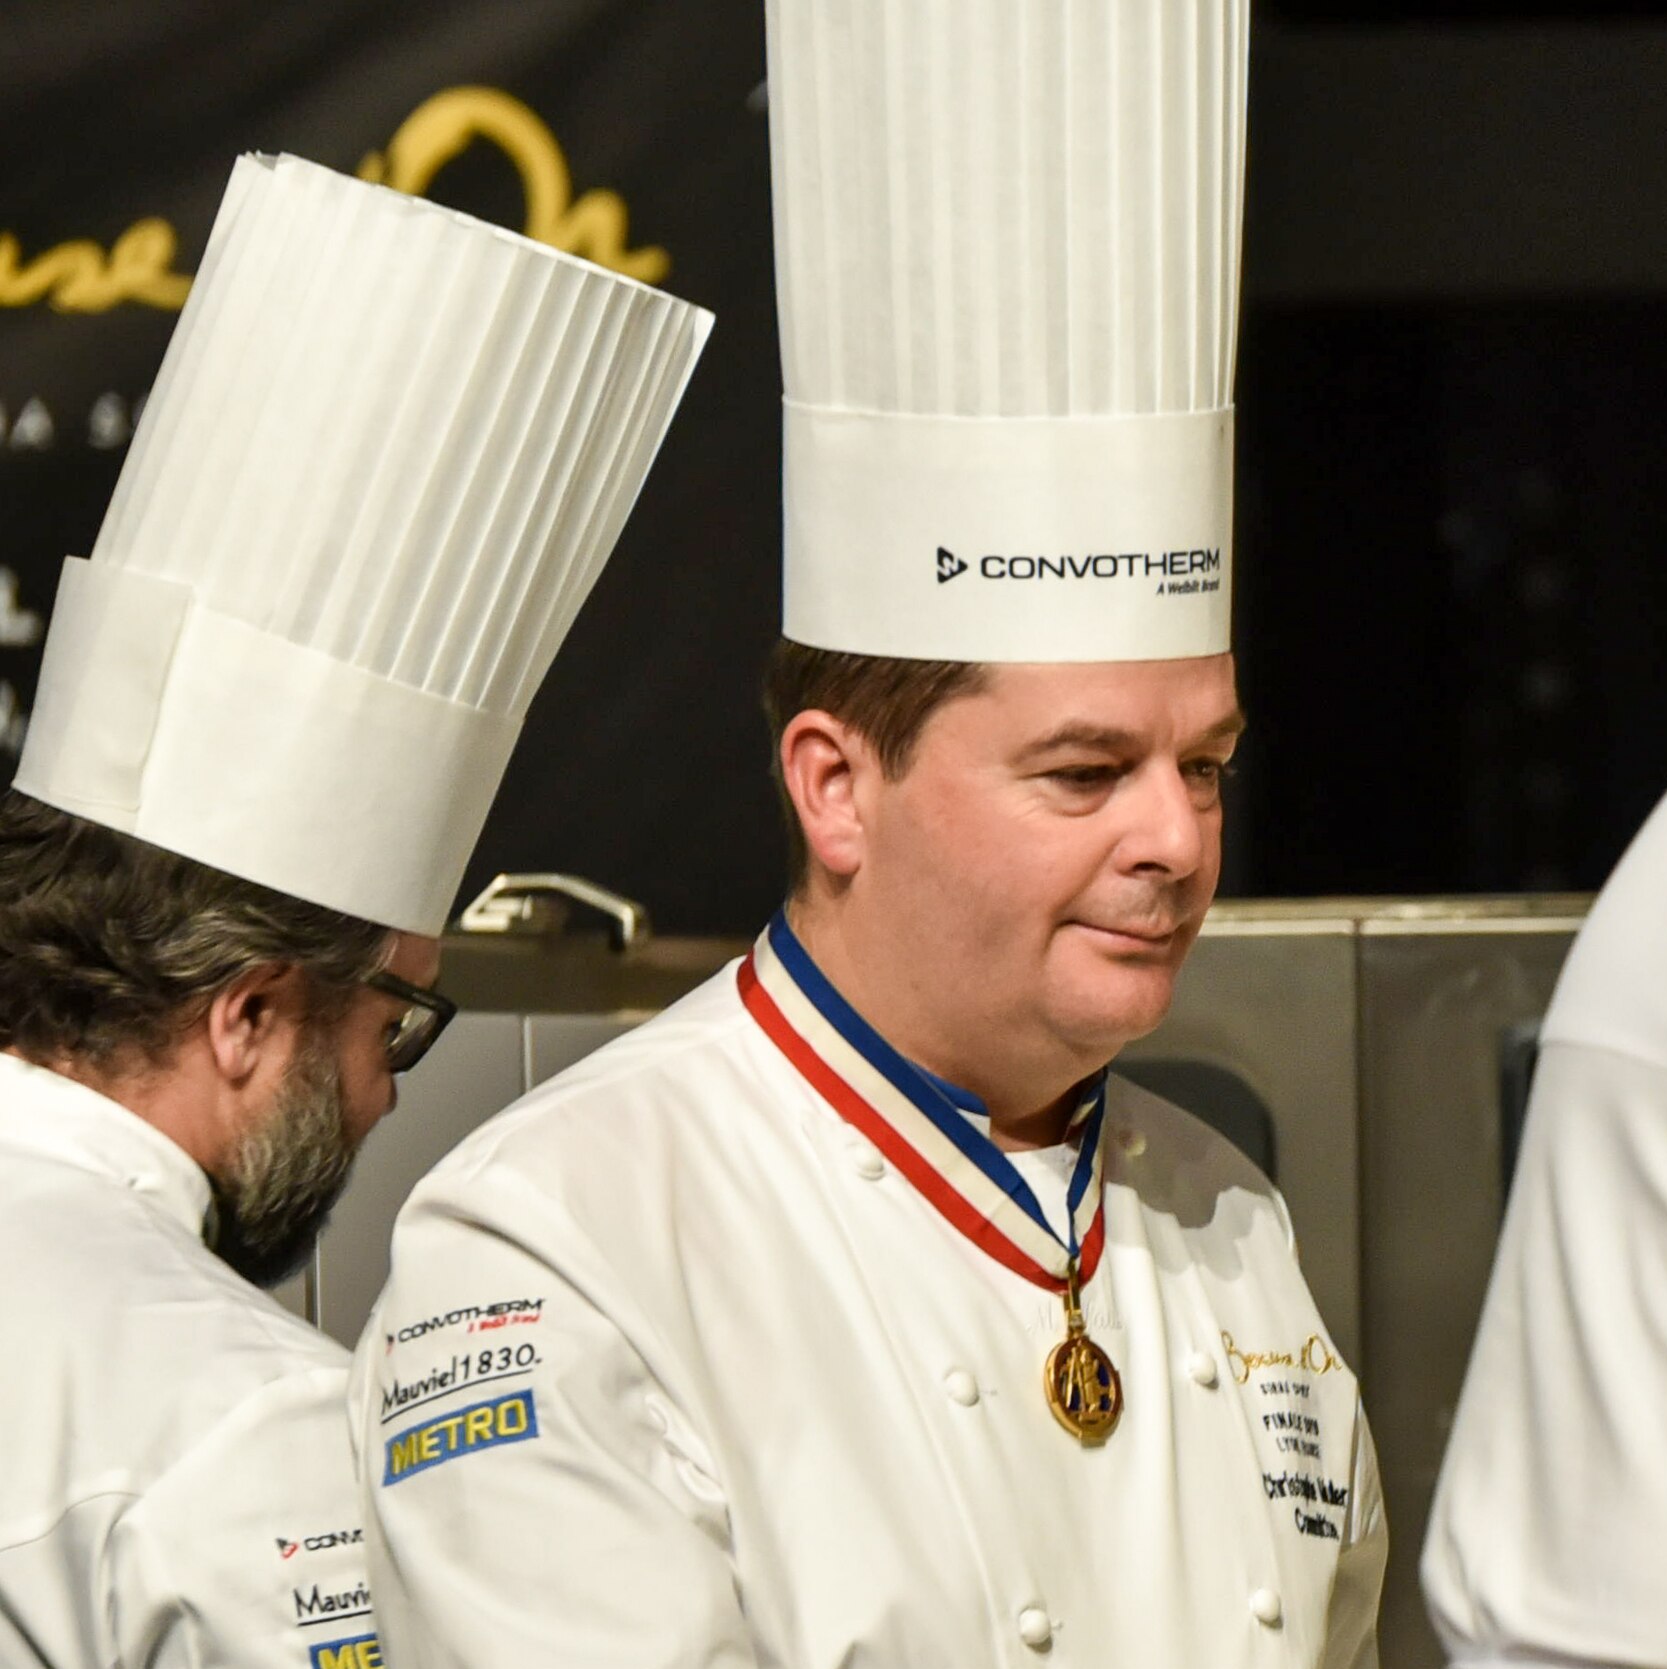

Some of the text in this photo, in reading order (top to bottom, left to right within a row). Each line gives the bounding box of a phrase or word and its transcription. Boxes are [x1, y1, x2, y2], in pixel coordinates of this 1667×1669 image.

[980, 548, 1220, 579] CONVOTHERM
[398, 1299, 544, 1343] CONVOTHERM
[391, 1399, 528, 1476] METRO
